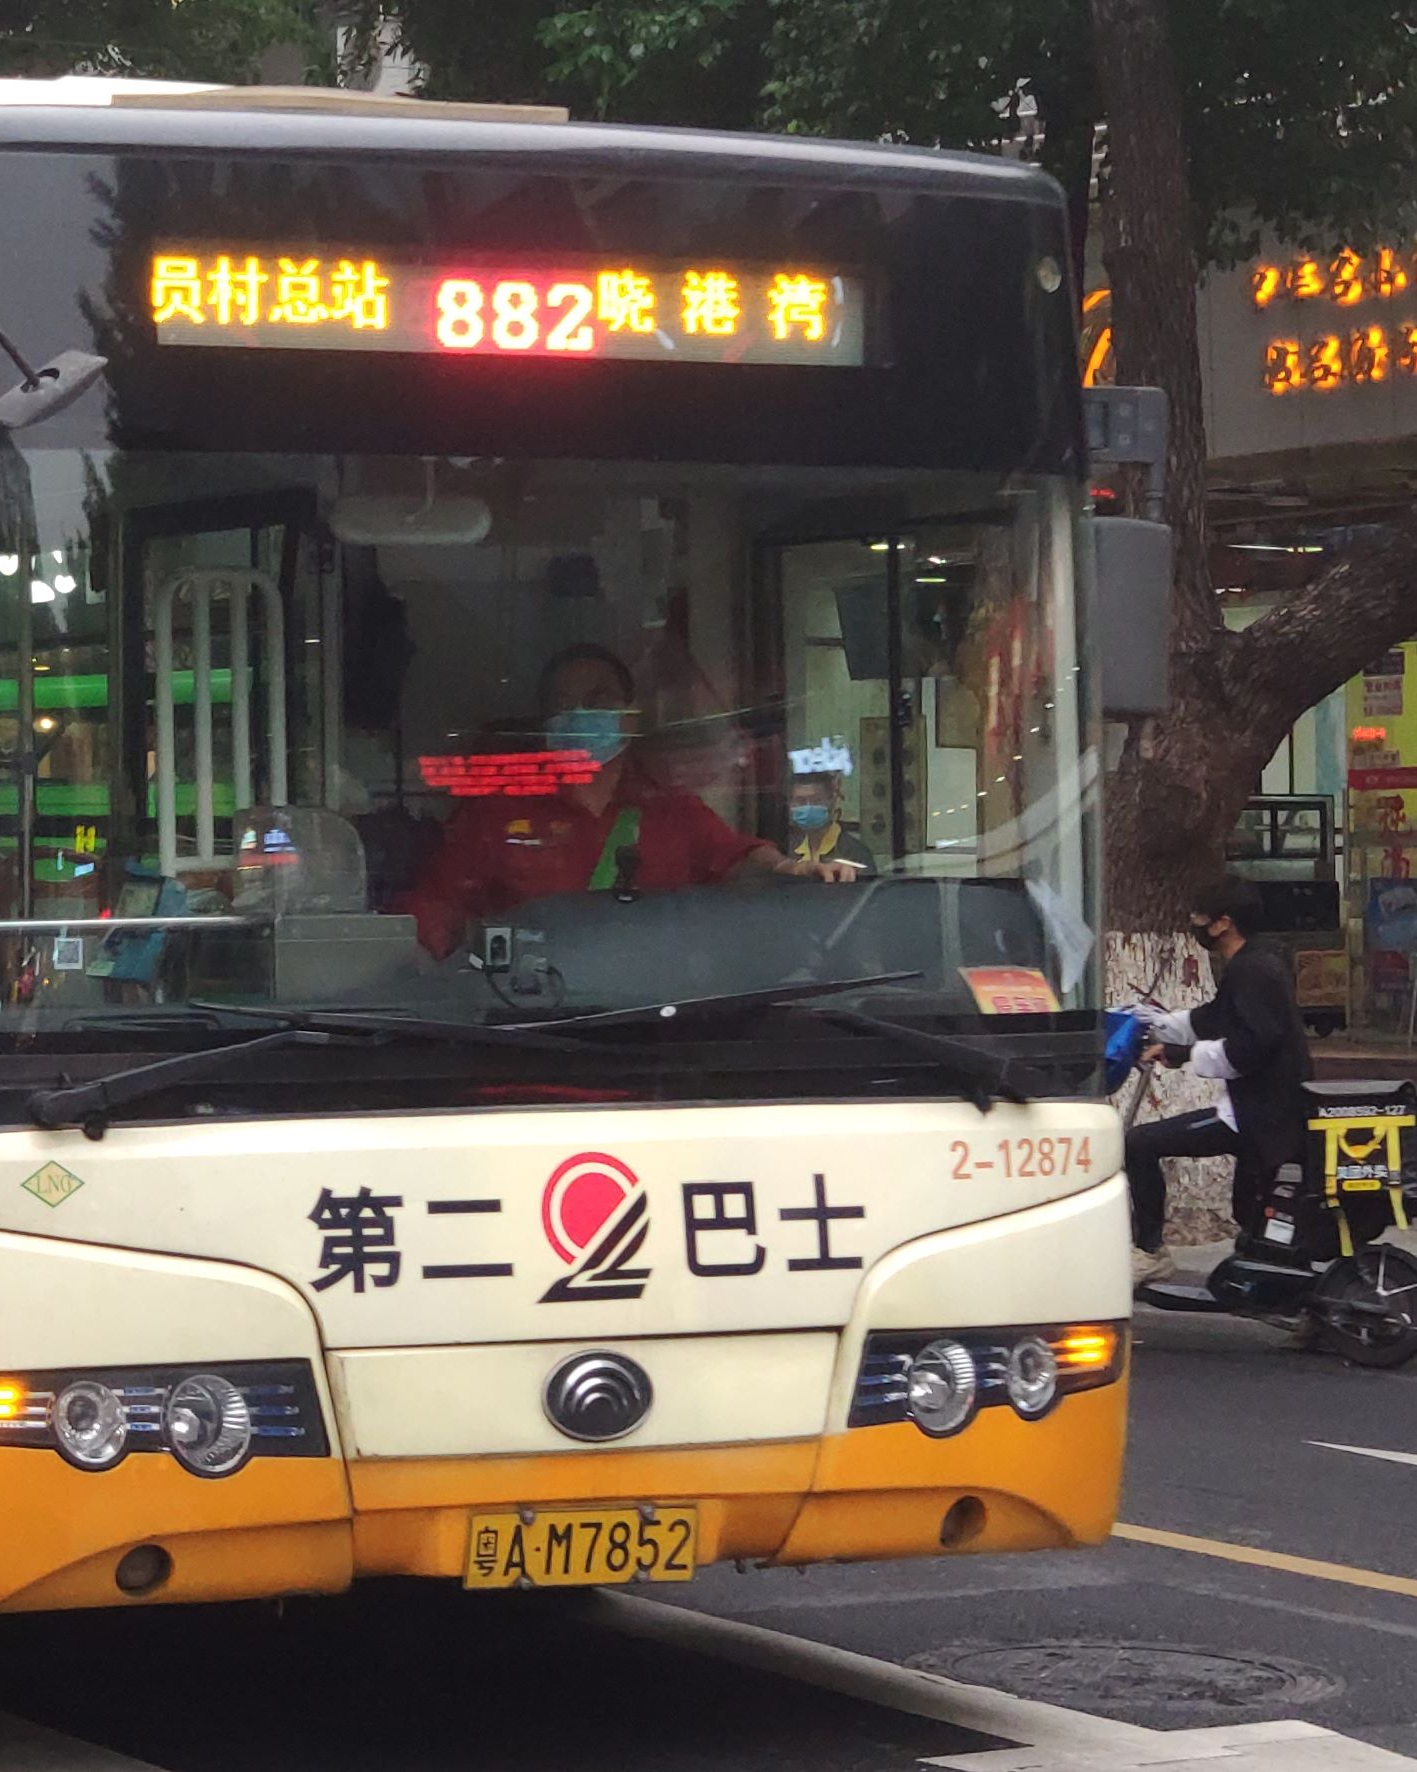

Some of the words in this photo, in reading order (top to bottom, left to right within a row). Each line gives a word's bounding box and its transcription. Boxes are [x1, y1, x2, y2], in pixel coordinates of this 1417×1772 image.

[152, 256, 390, 330] 员村总站
[436, 278, 595, 351] 882
[950, 1137, 1092, 1180] 2-12874
[307, 1185, 514, 1293] 第二
[680, 1173, 866, 1277] 巴士
